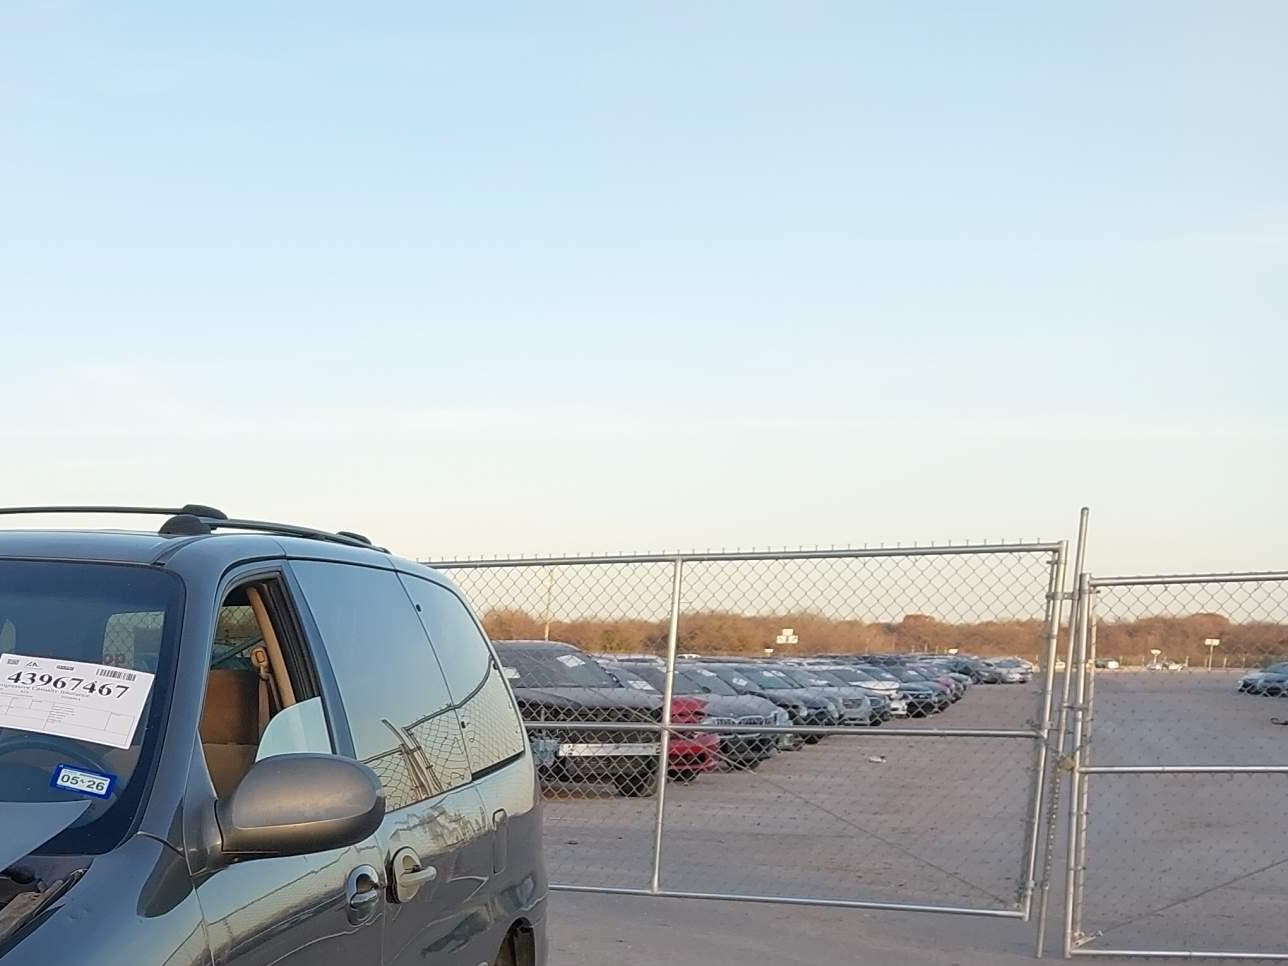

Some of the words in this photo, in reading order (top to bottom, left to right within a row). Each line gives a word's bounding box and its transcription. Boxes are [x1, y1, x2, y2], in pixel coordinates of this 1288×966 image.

[7, 671, 130, 699] 43967467
[61, 774, 80, 785] 05
[86, 779, 106, 791] 26
